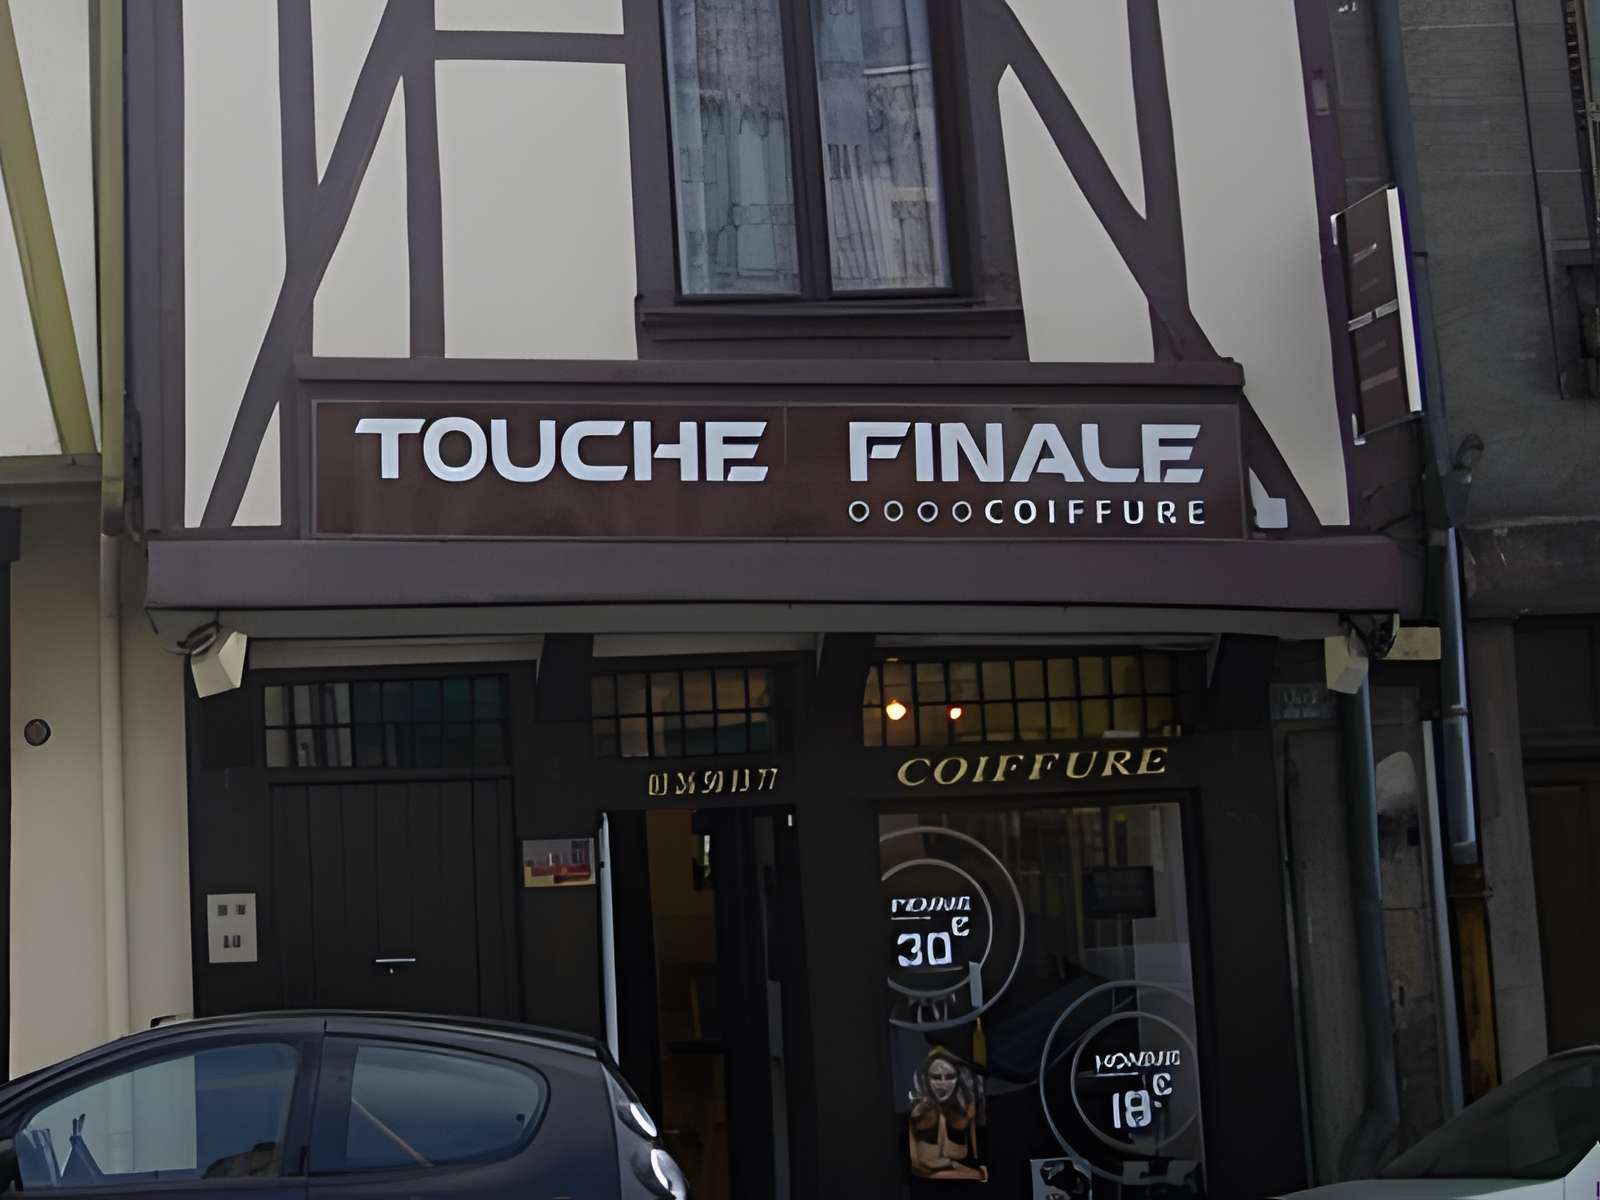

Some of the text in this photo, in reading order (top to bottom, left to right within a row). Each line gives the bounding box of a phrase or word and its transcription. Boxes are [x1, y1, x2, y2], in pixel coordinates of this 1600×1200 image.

[354, 416, 1205, 483] TOUCHE FINALE
[984, 499, 1205, 525] COIFFURE
[896, 746, 1169, 787] COIFFURE
